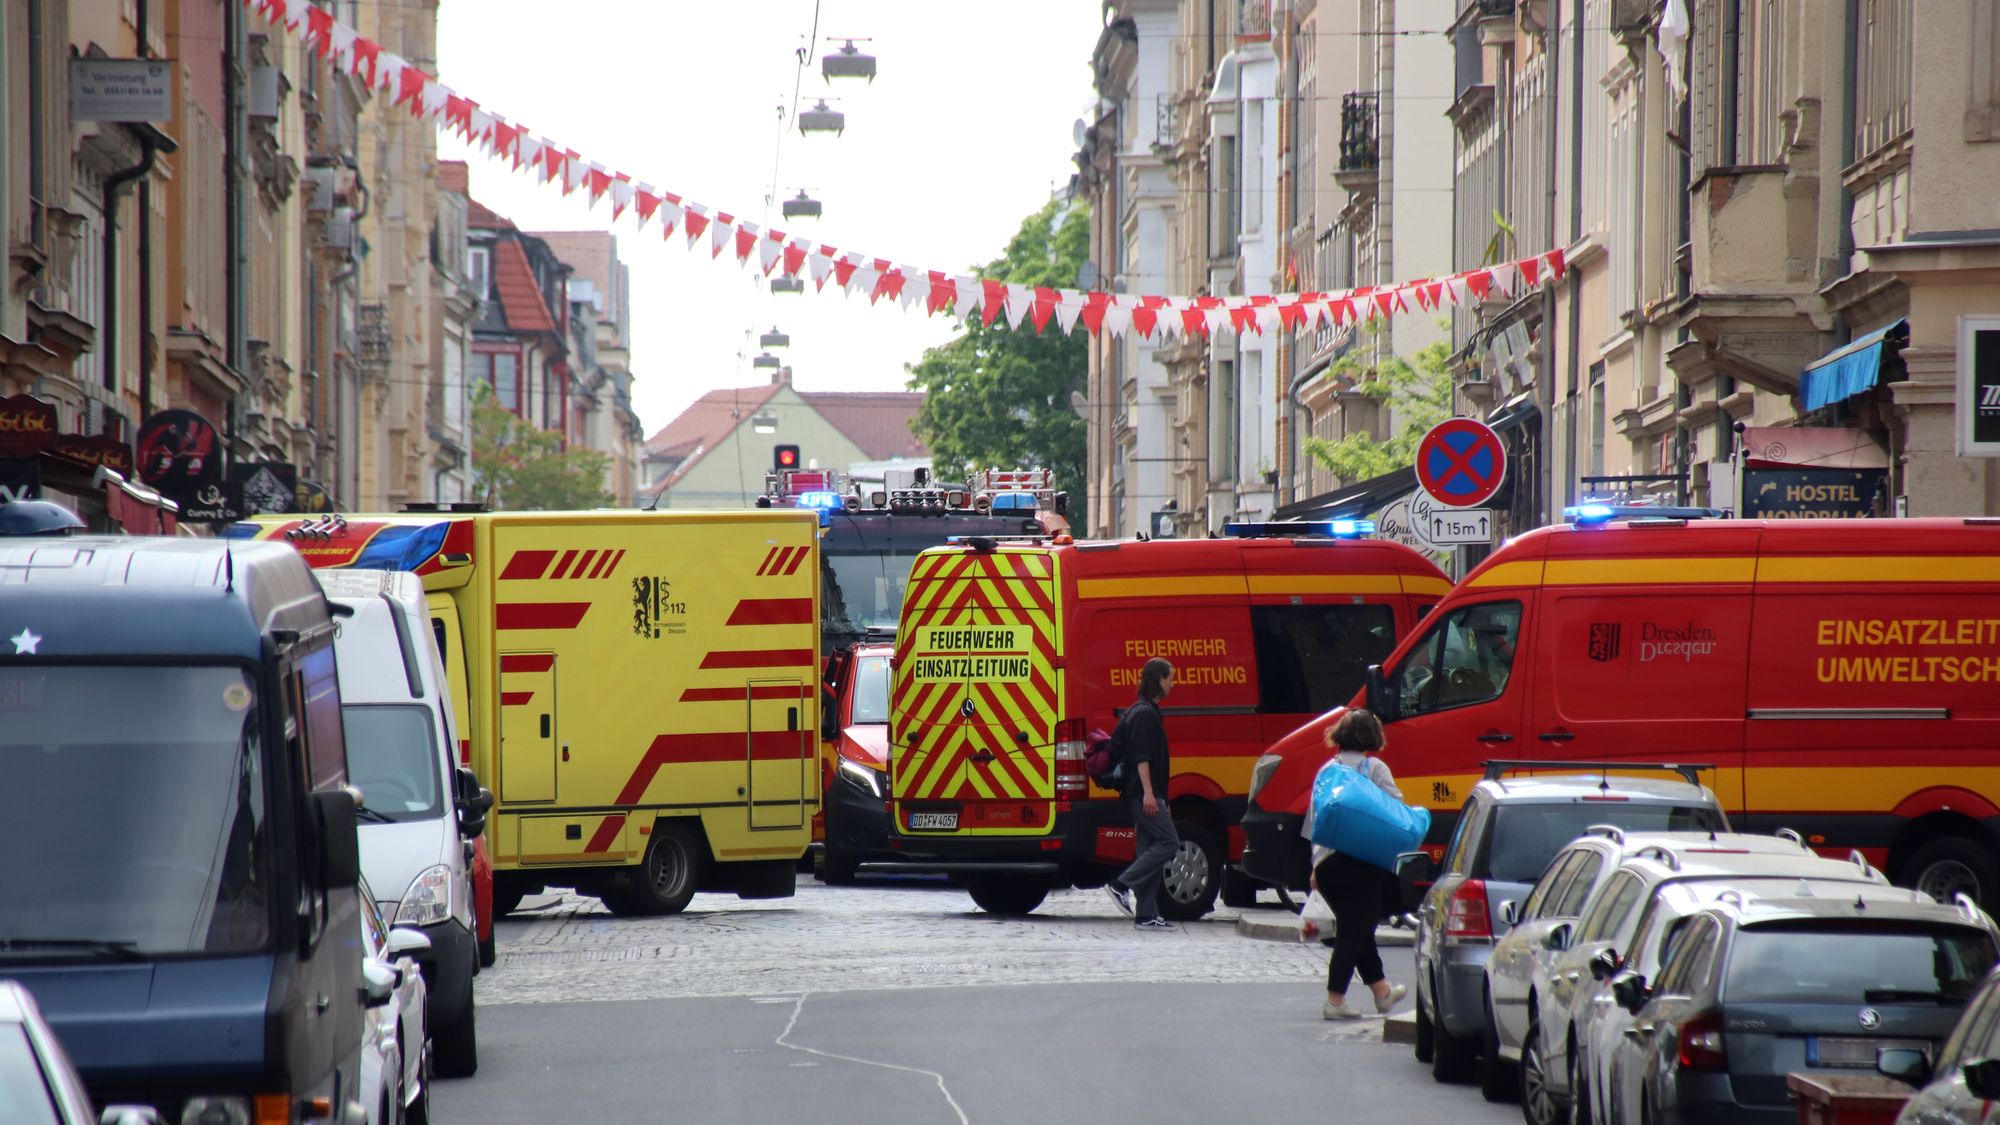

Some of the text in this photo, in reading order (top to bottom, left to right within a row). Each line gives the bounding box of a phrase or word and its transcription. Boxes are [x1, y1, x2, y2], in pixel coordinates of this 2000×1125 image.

[92, 72, 147, 85] Vermietung
[1786, 485, 1860, 502] HOSTEL
[186, 508, 217, 518] Curry
[670, 602, 686, 614] 112
[929, 630, 1014, 650] FEUERWEHR
[1817, 619, 2000, 646] EINSATZLEIT
[1125, 638, 1227, 657] FEUERWEHR
[915, 658, 1029, 678] EINSATZLEITUNG
[1817, 656, 2000, 683] UMWELTSCH
[913, 815, 923, 827] DD
[938, 815, 957, 826] 4057
[1104, 831, 1135, 839] BINZ
